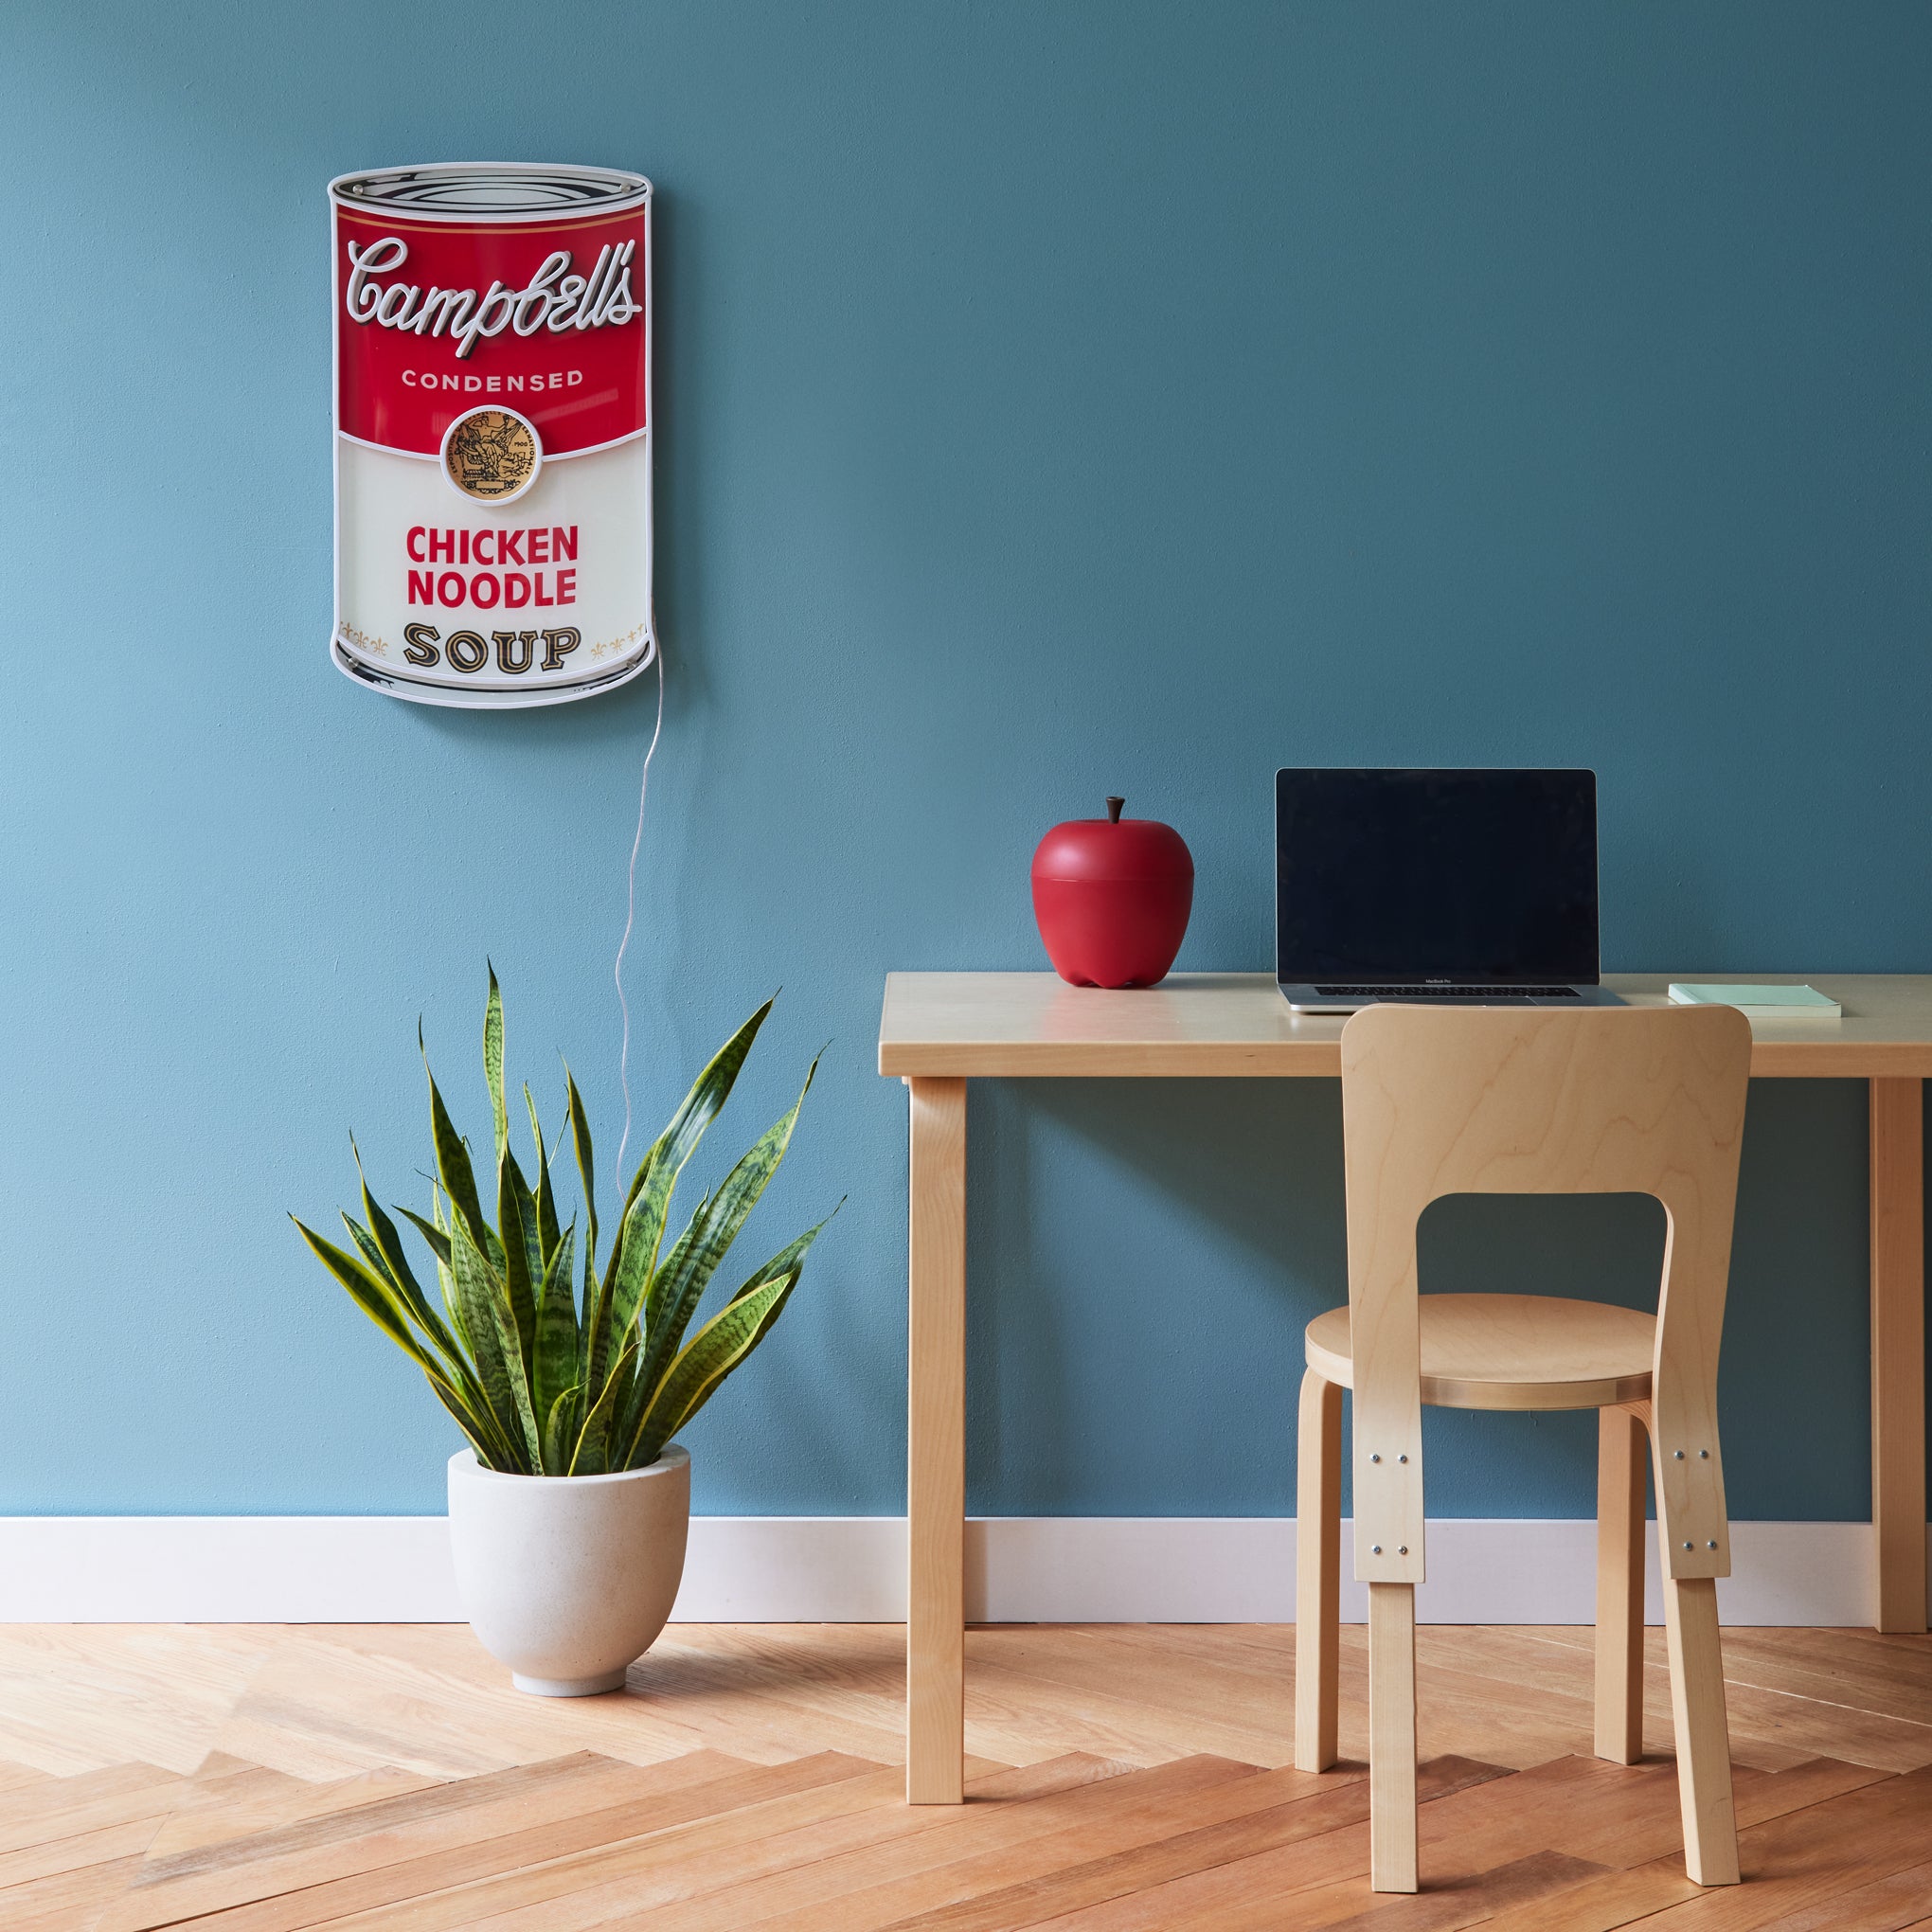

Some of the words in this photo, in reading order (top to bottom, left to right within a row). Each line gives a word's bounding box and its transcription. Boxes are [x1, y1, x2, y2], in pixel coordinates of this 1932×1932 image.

[347, 237, 643, 359] Campbell's
[402, 369, 583, 392] CONDENSED
[406, 526, 579, 566] CHICKEN
[407, 568, 576, 610] NOODLE
[402, 622, 581, 674] SOUP
